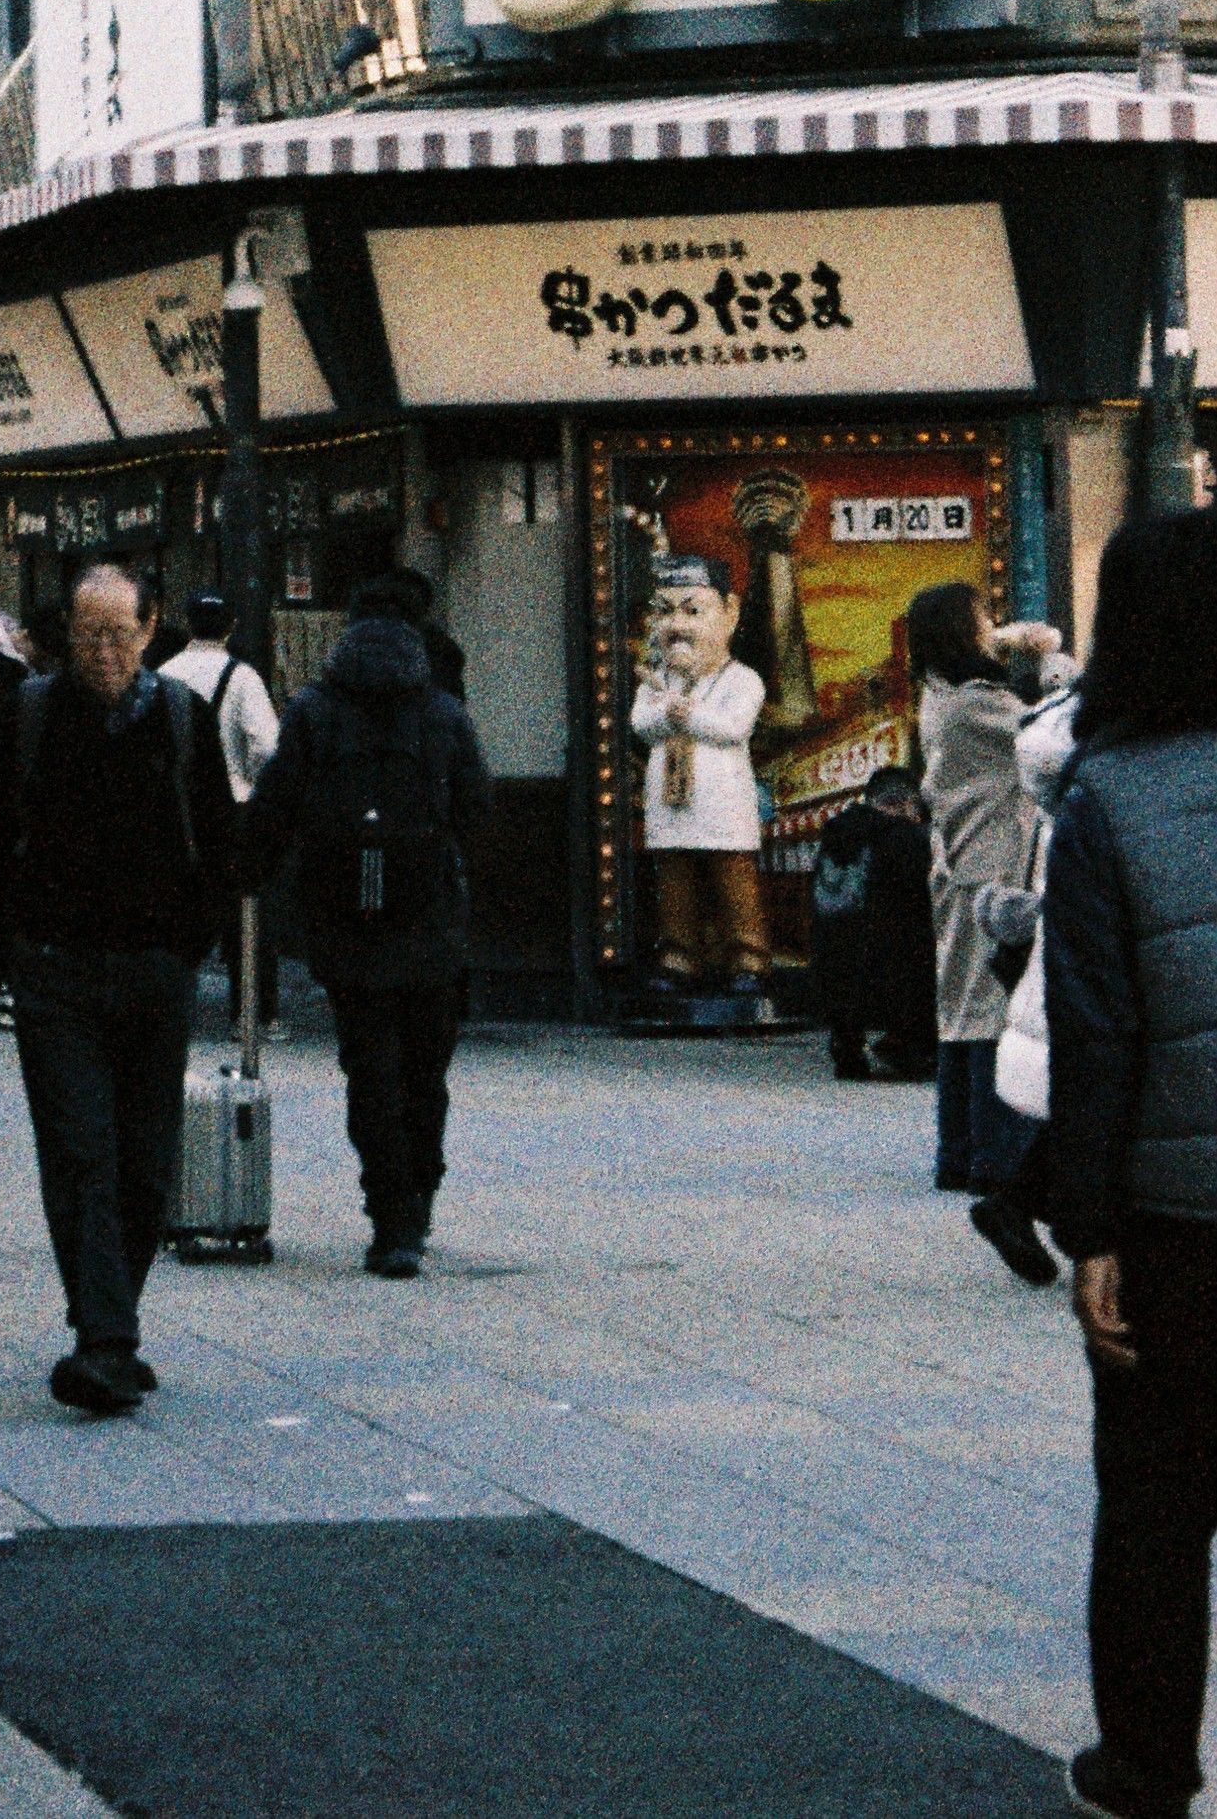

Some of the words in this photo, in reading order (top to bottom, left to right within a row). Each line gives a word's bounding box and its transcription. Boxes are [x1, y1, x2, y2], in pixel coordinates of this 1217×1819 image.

[540, 259, 853, 351] 串かつだるま
